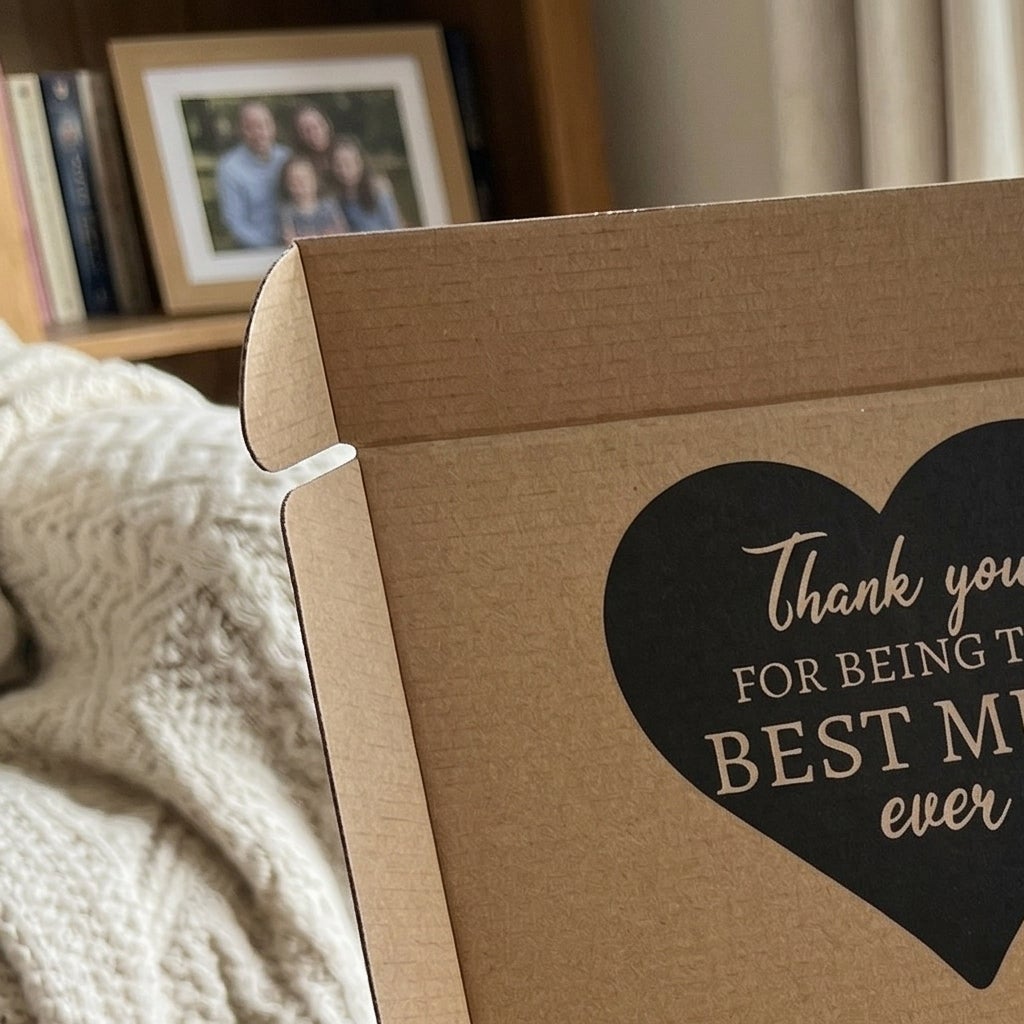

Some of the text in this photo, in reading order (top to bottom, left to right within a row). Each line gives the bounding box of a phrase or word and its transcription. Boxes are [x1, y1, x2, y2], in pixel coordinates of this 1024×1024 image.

[741, 531, 924, 632] Thank
[732, 657, 828, 704] FOR
[834, 633, 986, 689] BEING
[704, 705, 911, 796] BEST
[880, 783, 1013, 839] ever
